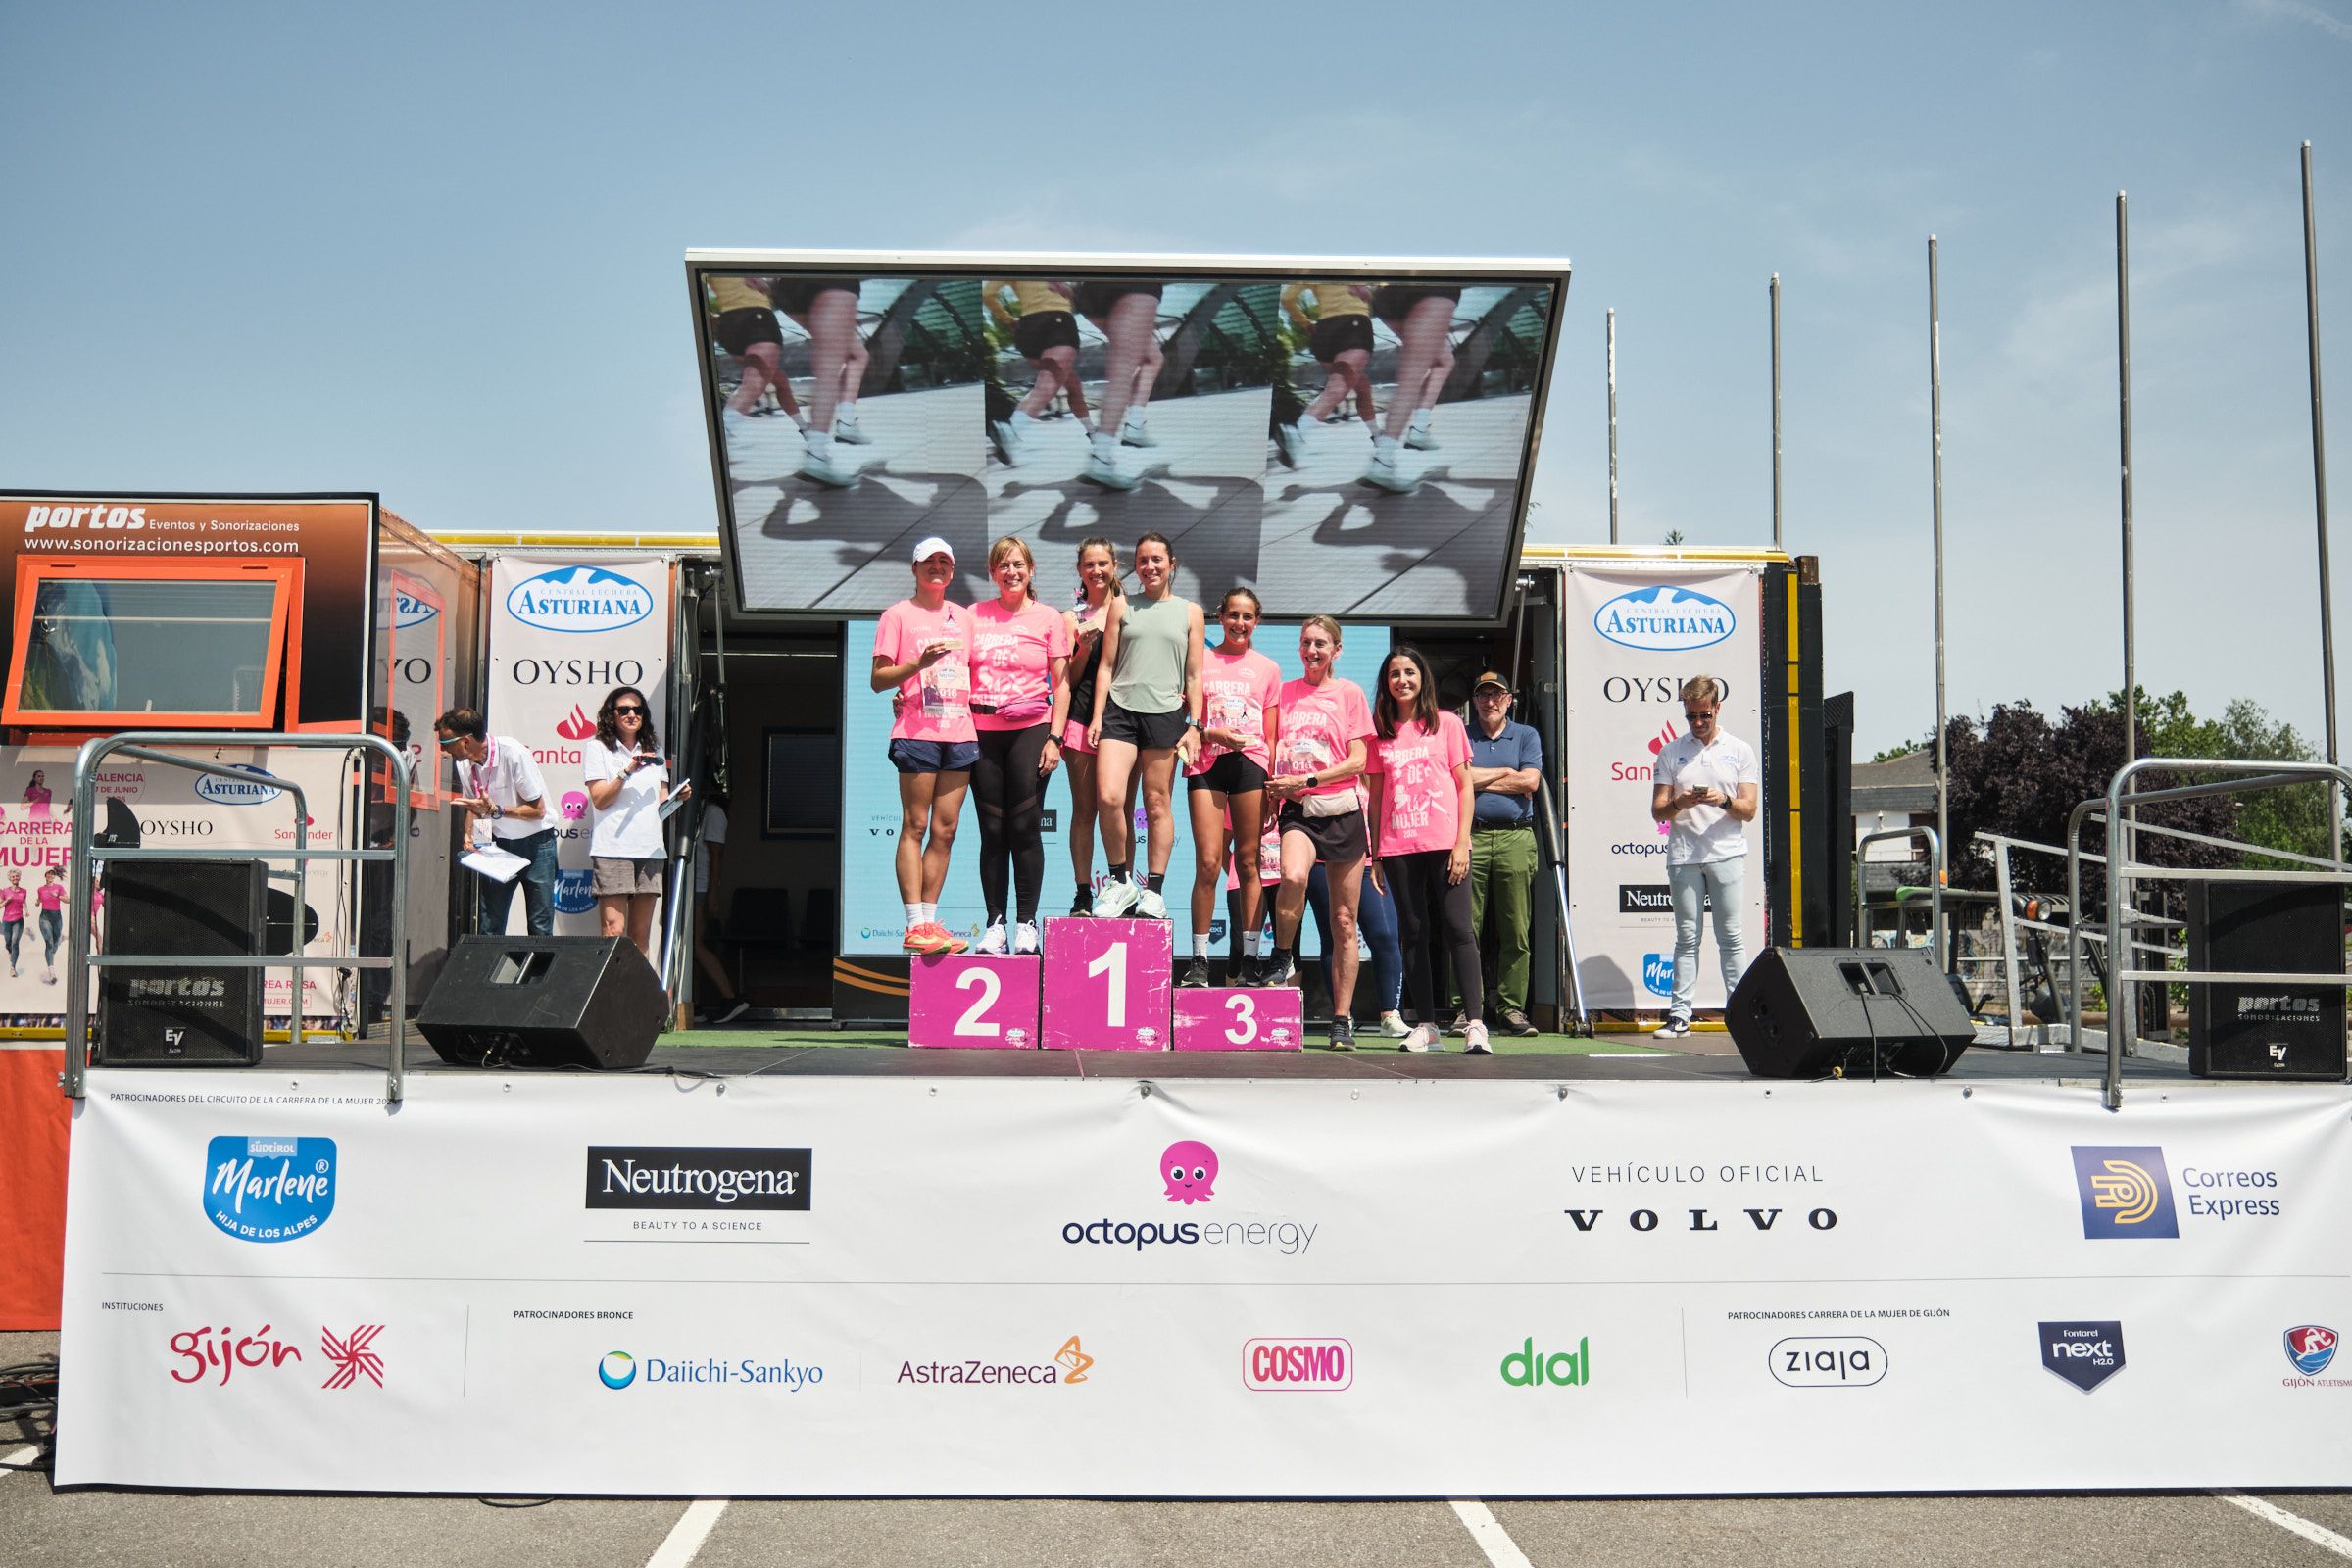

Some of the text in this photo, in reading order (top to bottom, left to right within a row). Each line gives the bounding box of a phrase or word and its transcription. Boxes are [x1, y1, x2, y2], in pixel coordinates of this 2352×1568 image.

[24, 504, 300, 532] portos Eventos y Sonorizaciones
[24, 537, 299, 554] www.sonorizacionesportos.com
[517, 590, 642, 615] ASTURIANA
[1606, 609, 1726, 634] ASTURIANA
[513, 659, 644, 686] OYSHO
[95, 773, 144, 782] ALENCIA
[1407, 763, 1424, 785] DE
[202, 778, 276, 795] ASTURIANA
[140, 819, 214, 836] OYSHO
[1391, 811, 1429, 830] MUJER
[129, 978, 225, 998] portos
[285, 980, 317, 990] RSA
[1088, 942, 1127, 1028] 1
[954, 966, 1002, 1037] 2
[2237, 995, 2320, 1013] portos
[1224, 994, 1258, 1046] 3
[165, 1029, 184, 1046] EV
[2269, 1045, 2287, 1061] EV
[110, 1093, 186, 1102] PATROCINADORES
[207, 1095, 248, 1103] CIRCUITO
[276, 1096, 316, 1104] CARRERA
[345, 1097, 374, 1105] MUJER
[602, 1159, 797, 1203] Neutrogena
[1572, 1162, 1824, 1183] VEHÍCULO OFICIAL
[2182, 1167, 2278, 1188] Correos
[2188, 1195, 2280, 1221] Express
[215, 1210, 318, 1238] HIJA DE LOS ALPES
[633, 1221, 678, 1230] BEAUTY
[682, 1221, 697, 1230] TO
[712, 1222, 762, 1231] SCIENCE
[1564, 1207, 1838, 1232] VOLVO
[1062, 1218, 1318, 1255] octopus energy
[102, 1301, 164, 1312] INSTITUCIONES
[514, 1310, 634, 1320] PATROCINADORES BRONCE
[1727, 1311, 1806, 1320] PATROCINADORES
[1808, 1310, 1848, 1319] CARRERA
[1878, 1309, 1908, 1318] MUJER
[1910, 1309, 1921, 1318] DE
[1923, 1307, 1950, 1318] GIJÓN
[2063, 1329, 2099, 1338] Fontarel
[170, 1324, 302, 1387] gijón
[2052, 1339, 2114, 1358] next
[898, 1360, 1057, 1384] AstraZeneca
[1252, 1345, 1345, 1383] COSMO
[1500, 1336, 1589, 1388] dial
[1786, 1350, 1871, 1381] ziaja
[646, 1358, 824, 1393] Daiichi-Sankyo
[2282, 1376, 2315, 1389] GIJÓN
